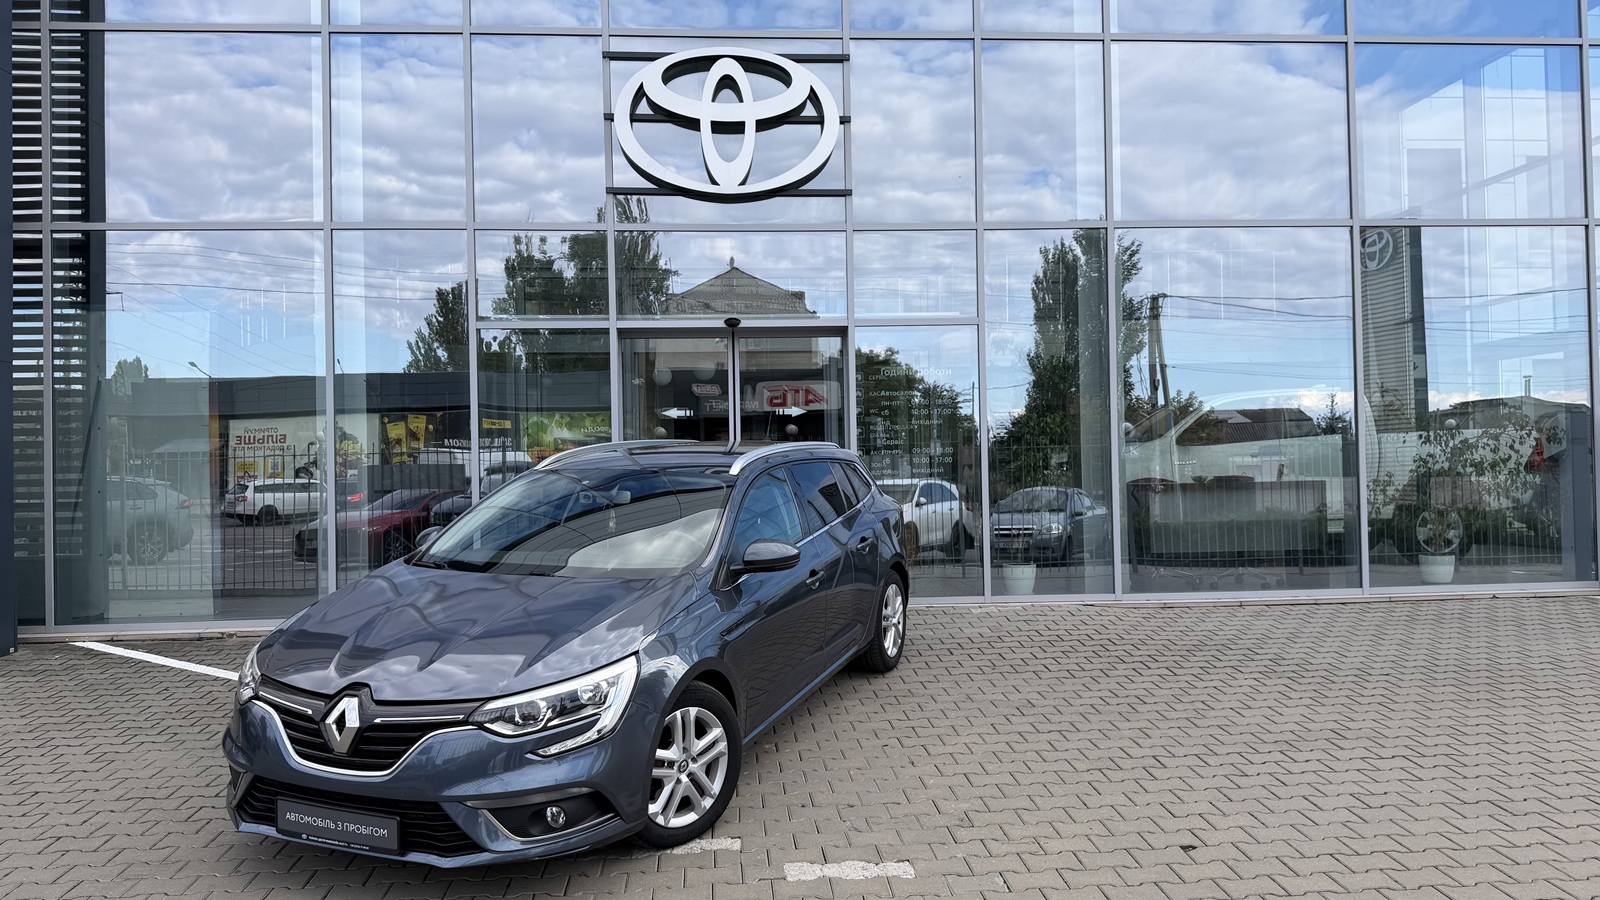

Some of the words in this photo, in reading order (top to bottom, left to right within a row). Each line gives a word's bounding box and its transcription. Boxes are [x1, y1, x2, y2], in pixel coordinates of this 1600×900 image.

[881, 367, 915, 377] Години
[917, 366, 952, 378] роботи
[285, 811, 336, 830] АВТОМОБІЛЬ
[336, 821, 343, 831] З
[343, 822, 388, 838] ПРОБІГОМ
